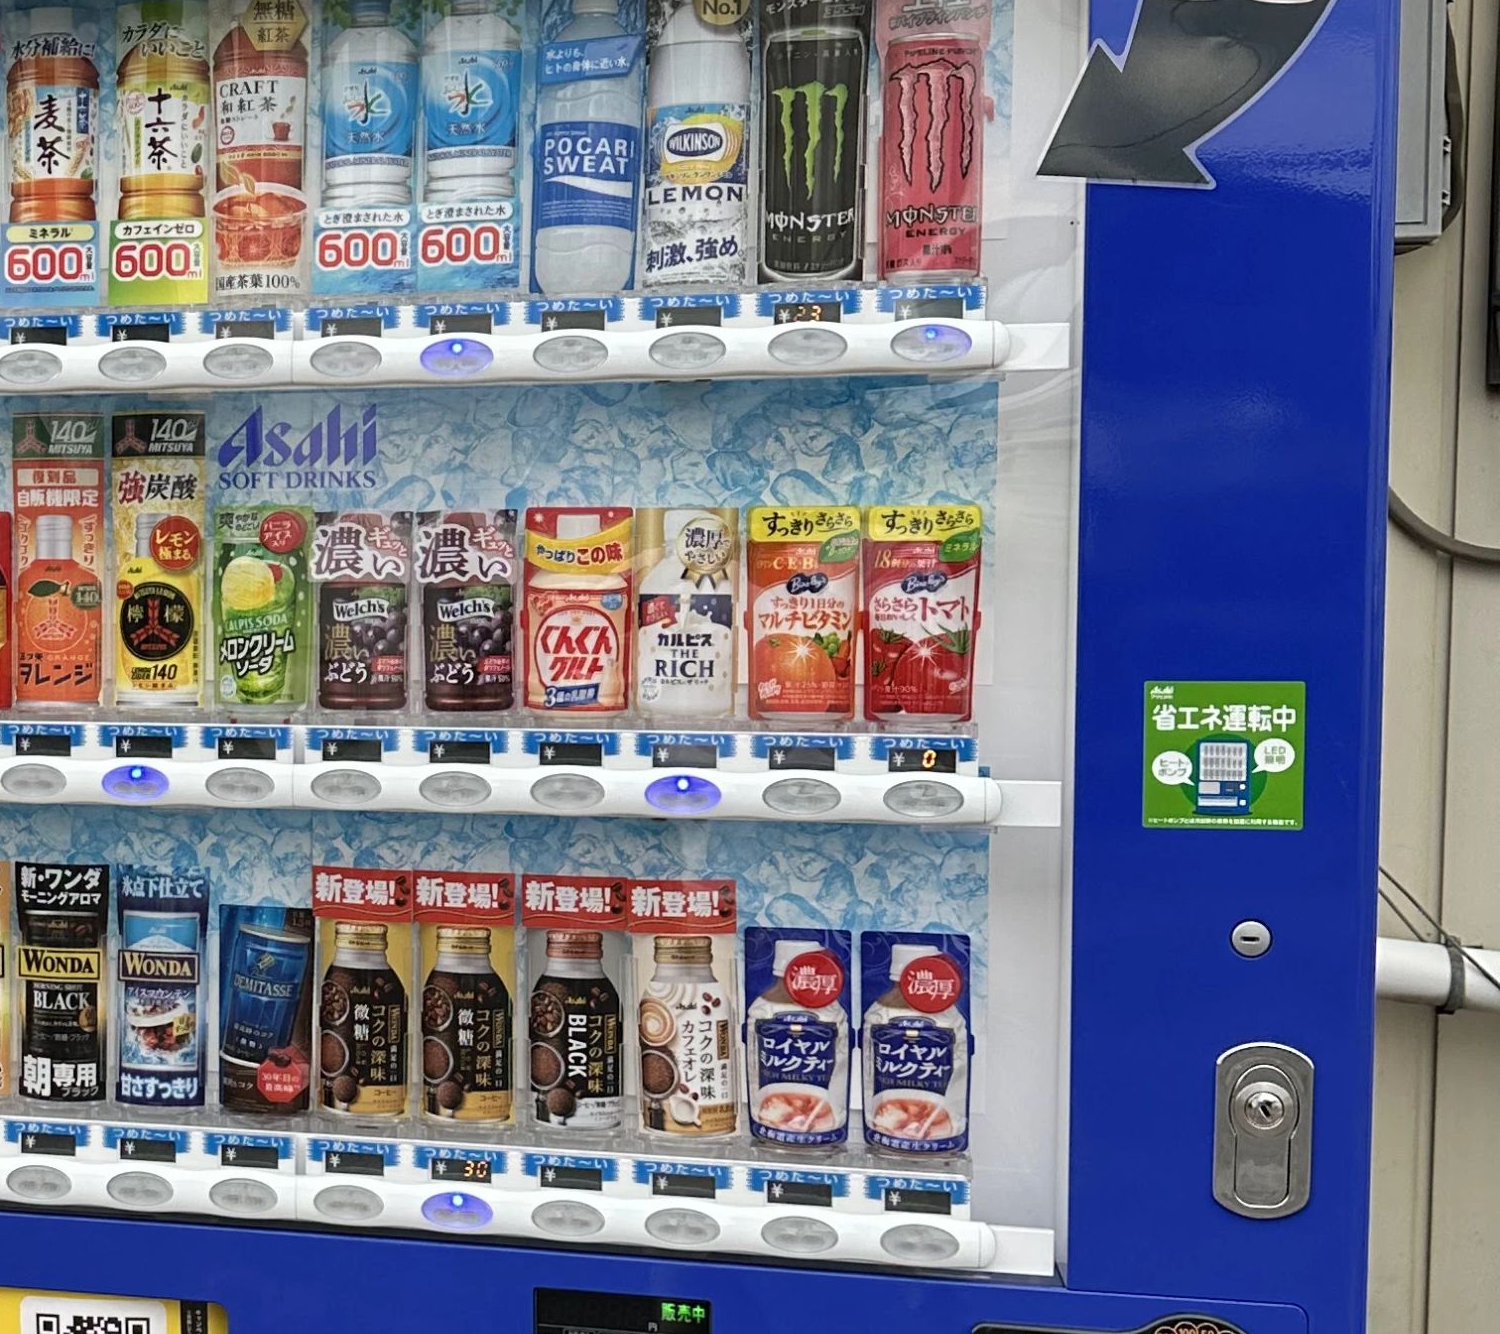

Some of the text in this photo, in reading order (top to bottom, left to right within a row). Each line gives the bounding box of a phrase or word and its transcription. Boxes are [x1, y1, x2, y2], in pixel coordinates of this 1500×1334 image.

[254, 0, 296, 21] 無糖
[702, 0, 742, 16] No.1
[122, 23, 182, 43] カラダに
[256, 27, 290, 43] 紅茶
[12, 37, 96, 59] 水分補給に!
[142, 41, 206, 59] いいこと
[220, 80, 279, 97] CRAFT
[220, 95, 278, 115] 和紅茶
[34, 94, 70, 174] 麦茶
[144, 88, 178, 170] 十六茶
[544, 138, 634, 158] POCARI
[668, 127, 721, 154] WILKINSON
[544, 156, 628, 175] SWEAT
[648, 186, 743, 206] LEMON
[324, 213, 404, 224] とぎ澄まされた水
[426, 205, 506, 217] とぎ澄まされた水
[28, 229, 70, 239] ミネラル
[122, 223, 196, 235] カフェインゼロ
[906, 227, 965, 238] ENERGY
[318, 232, 398, 267] 600
[421, 226, 500, 264] 600
[646, 234, 738, 272] 刺激、強め
[8, 247, 83, 280] 600
[116, 243, 191, 277] 600
[216, 274, 300, 291] 国産茶葉100%
[218, 403, 377, 467] Asahi
[48, 443, 93, 454] MITSUYA
[148, 442, 193, 452] MITSUYA
[118, 471, 198, 505] 強炭酸
[219, 471, 376, 490] SOFT DRINKS
[18, 489, 99, 507] 自販機限定
[156, 529, 196, 547] レモン
[686, 528, 724, 550] 濃厚
[536, 543, 623, 565] やっぱりこの味
[334, 599, 386, 618] Welch's
[440, 600, 493, 619] Welch's
[758, 611, 850, 631] マルチビタミン
[220, 633, 295, 661] メロンクリーム
[541, 626, 612, 654] ぐんぐん
[658, 633, 713, 646] カルピス
[671, 649, 699, 658] THE
[236, 657, 272, 675] ソーダ
[324, 663, 367, 683] ぶどう
[430, 665, 474, 685] ぶどう
[551, 656, 603, 681] グルト
[655, 660, 714, 678] RICH
[1152, 705, 1296, 732] 省エネ運転中
[1264, 746, 1286, 754] LED
[122, 877, 203, 898] 氷点下仕立て
[315, 872, 396, 906] 新登場!
[416, 876, 498, 909] 新登場!
[525, 881, 611, 913] 新登場!
[631, 886, 720, 917] 新登場!
[124, 953, 192, 977] WONDA
[233, 974, 293, 997] DEMITASSE
[33, 990, 89, 1013] BLACK
[370, 1005, 386, 1081] コクの深味
[568, 1014, 587, 1078] BLACK
[681, 1021, 696, 1083] カフェオレ
[879, 1043, 948, 1060] ロイヤル
[699, 1020, 716, 1099] コクの深味
[875, 1059, 950, 1079] ミルクティー
[23, 1055, 97, 1096] 朝専用
[121, 1074, 199, 1099] 甘さすっきり
[661, 1303, 705, 1322] 販売中
